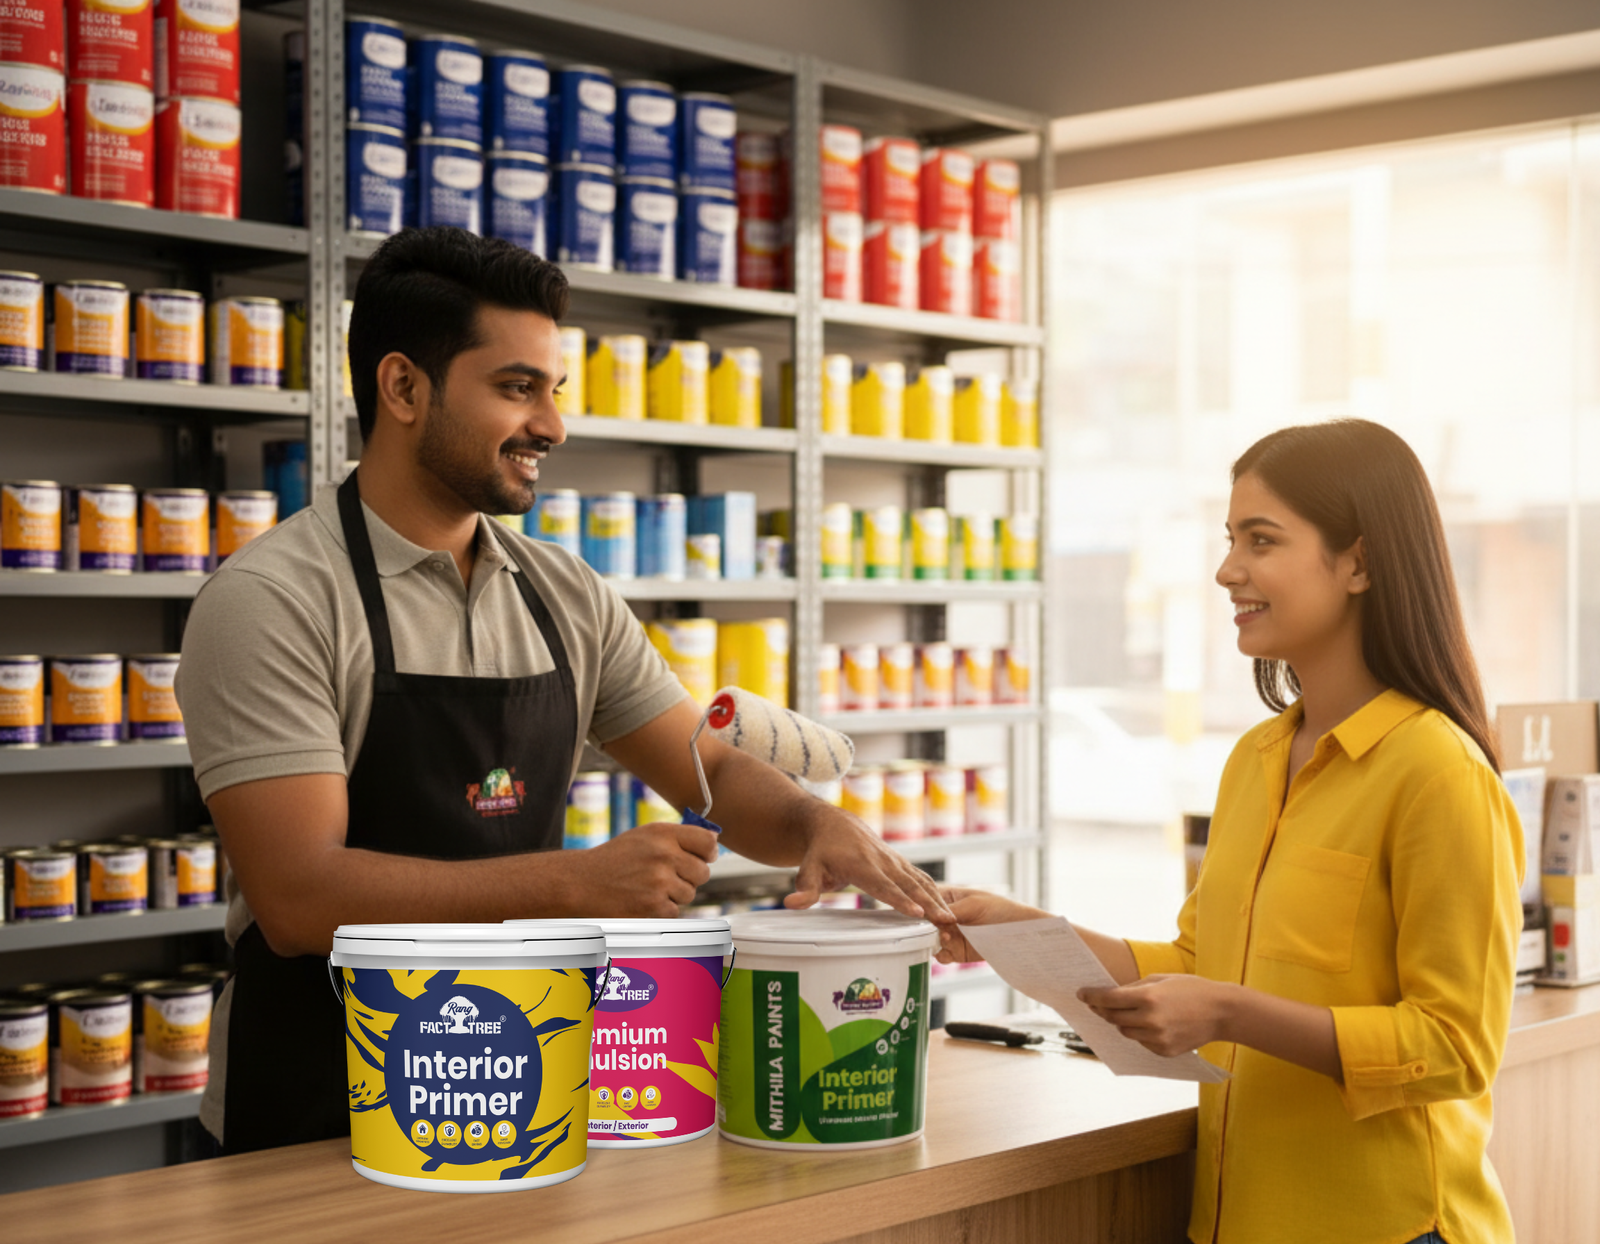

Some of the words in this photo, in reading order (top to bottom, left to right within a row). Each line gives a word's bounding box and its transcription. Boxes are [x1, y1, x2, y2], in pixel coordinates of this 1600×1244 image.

[620, 989, 650, 1001] TREE
[447, 1002, 473, 1016] Rang
[767, 980, 783, 1049] PAINTS
[420, 1021, 452, 1035] FACT
[467, 1021, 502, 1035] TREE
[592, 1021, 668, 1045] mium
[404, 1046, 528, 1080] Interior
[590, 1046, 667, 1071] ulsion
[818, 1063, 898, 1088] Interior
[409, 1082, 523, 1116] Primer
[768, 1056, 784, 1132] MITHILA
[822, 1087, 896, 1111] Primer
[618, 1121, 650, 1130] Exterior
